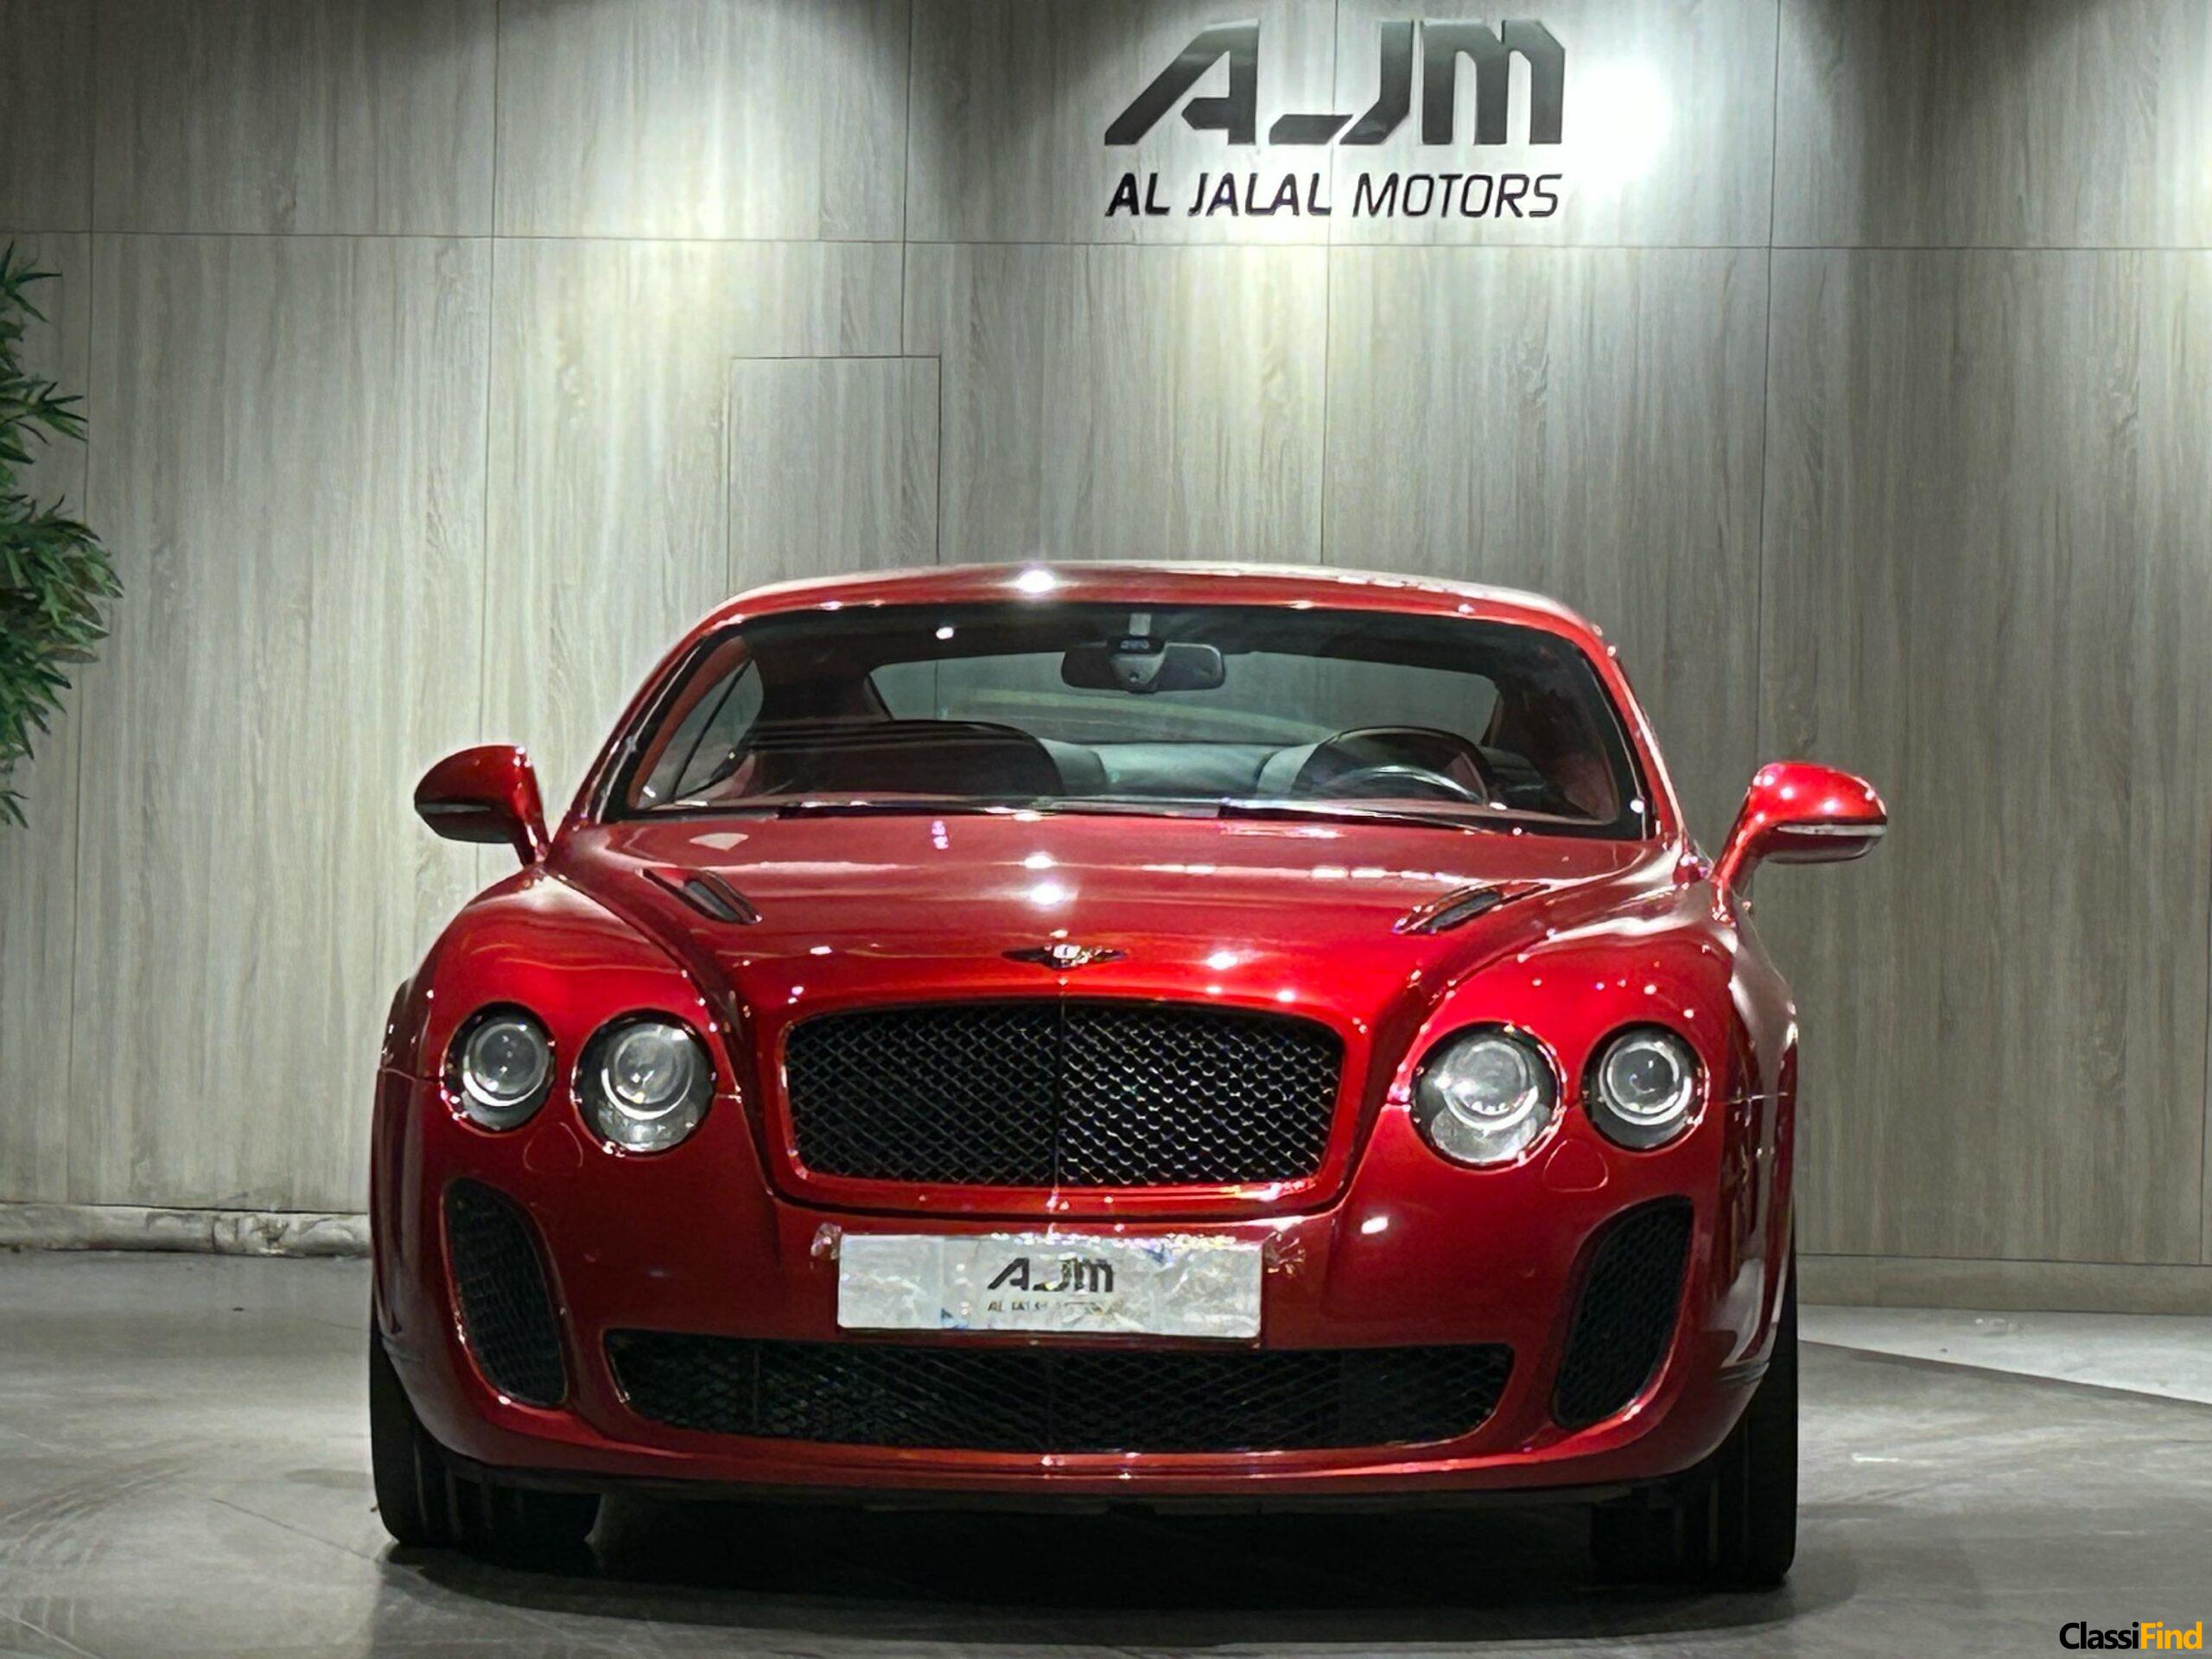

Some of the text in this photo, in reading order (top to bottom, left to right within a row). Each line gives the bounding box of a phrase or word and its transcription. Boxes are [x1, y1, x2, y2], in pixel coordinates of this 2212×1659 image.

[1105, 172, 1562, 218] AL JALAL MOTORS
